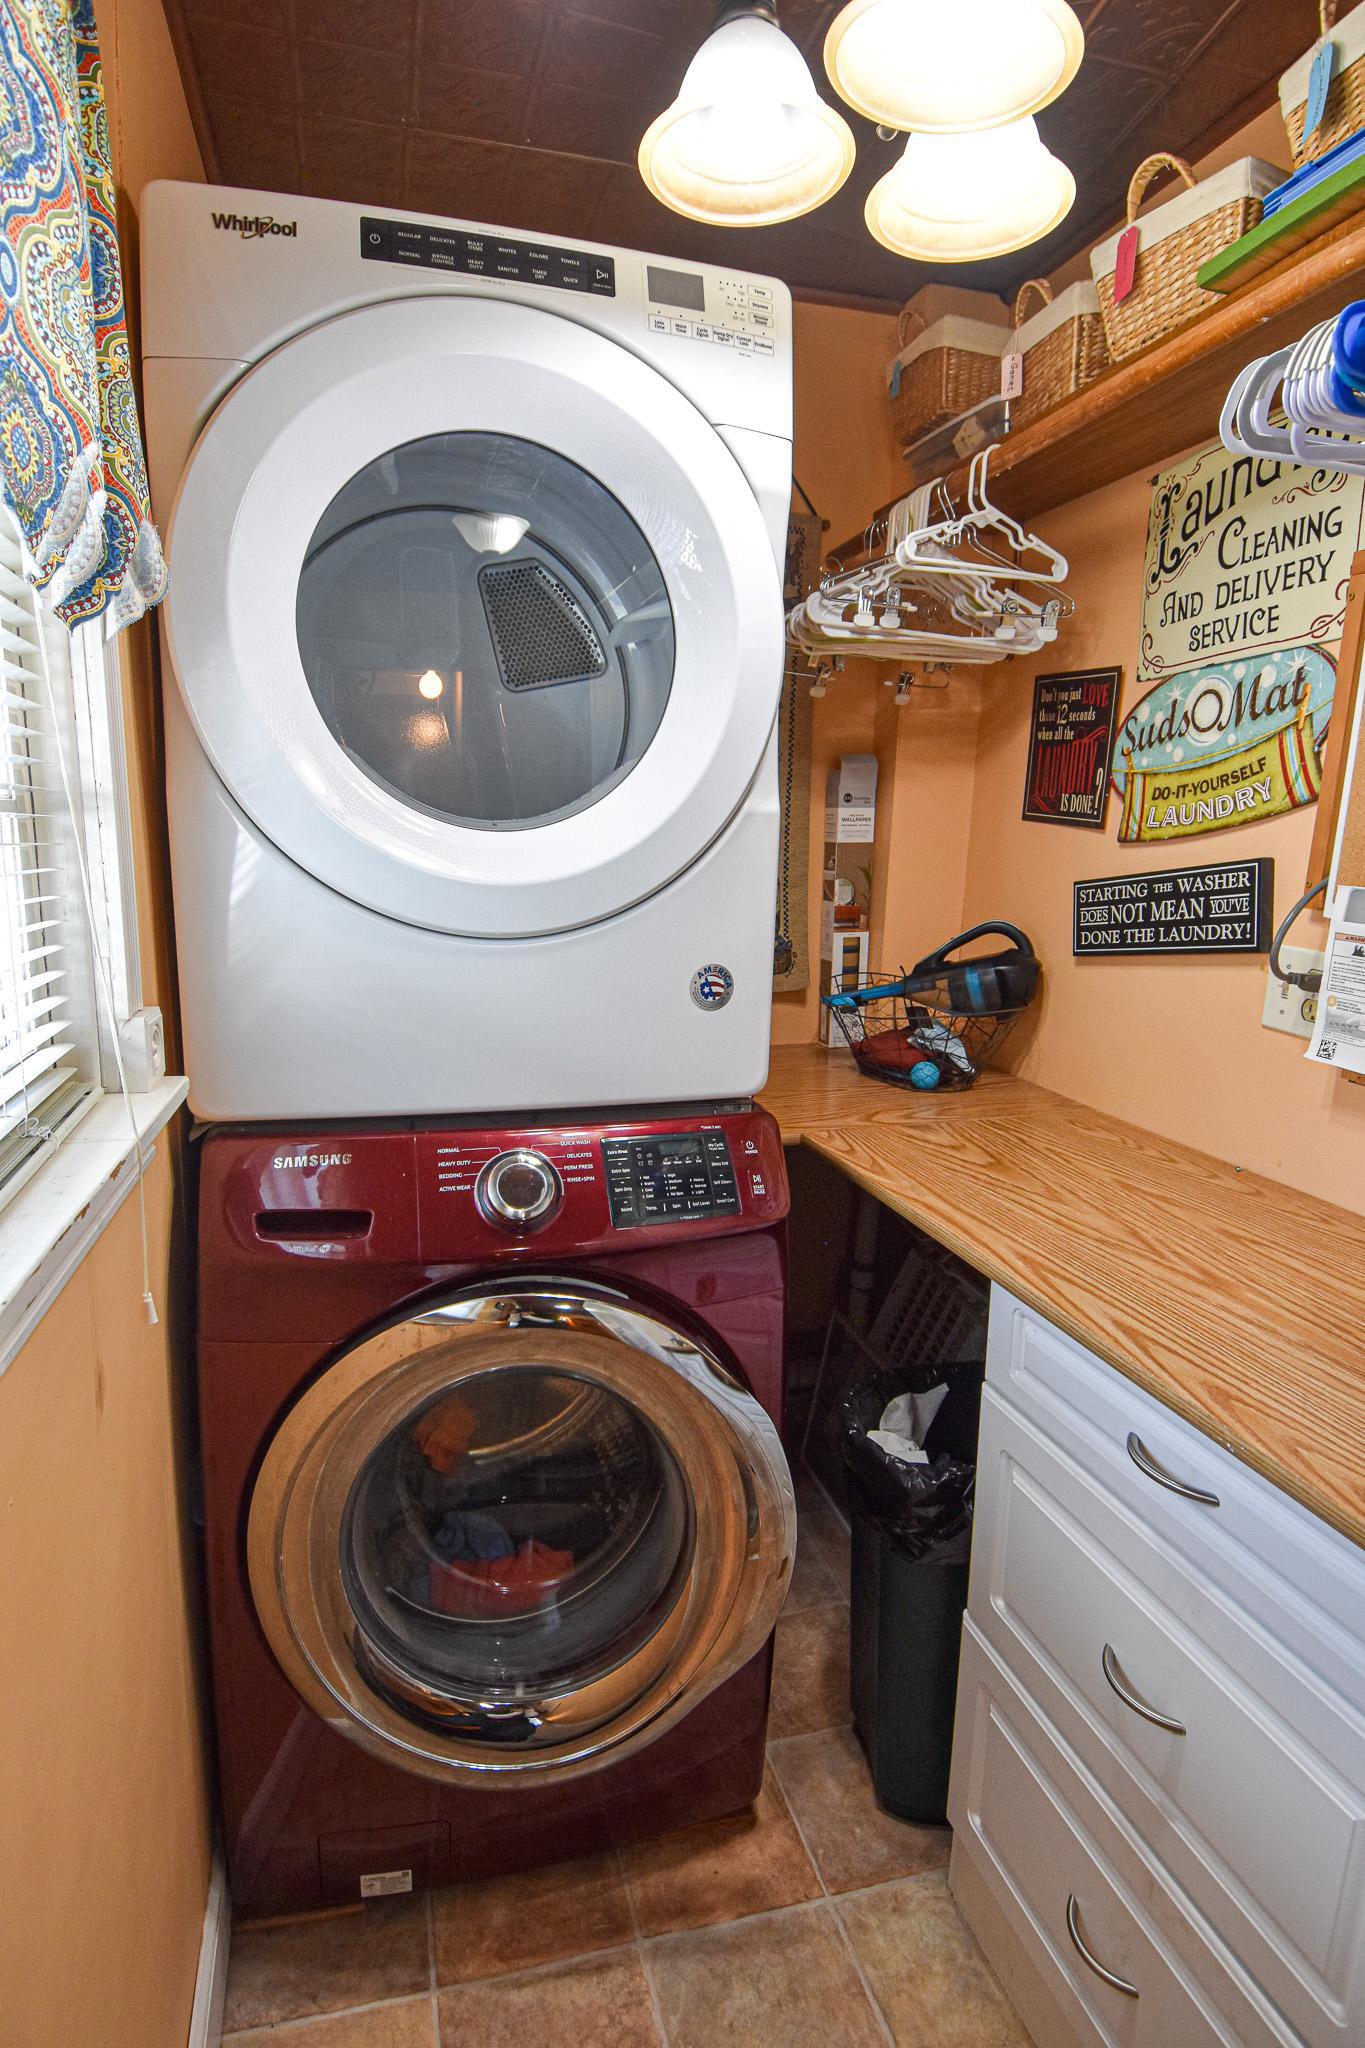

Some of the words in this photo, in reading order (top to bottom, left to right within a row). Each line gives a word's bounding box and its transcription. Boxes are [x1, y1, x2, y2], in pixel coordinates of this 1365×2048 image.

[212, 212, 297, 239] Whirlpool
[398, 231, 421, 239] REGULAR
[430, 236, 455, 245] DELICATES
[498, 247, 517, 255] WHITES
[398, 250, 421, 258] NORMAL
[529, 252, 549, 260] COLORS
[561, 258, 580, 266] TOWELS
[1218, 505, 1343, 569] CLEANING
[1215, 550, 1336, 611] DELIVERY
[1159, 591, 1203, 627] AND
[1189, 605, 1280, 652] SERVICE
[1069, 687, 1082, 703] just
[1082, 682, 1110, 708] LOVE
[1056, 703, 1068, 725] 12
[1068, 706, 1096, 722] seconds
[1037, 726, 1053, 740] when
[1054, 726, 1064, 740] all
[1064, 726, 1075, 740] the
[1033, 733, 1102, 801] LAUNDRY
[1151, 757, 1268, 801] DO-IT-YOURSELF
[1060, 793, 1069, 812] IS
[1146, 776, 1273, 828] LAUNDRY
[1080, 883, 1148, 903] STARTING
[1153, 882, 1174, 893] THE
[1177, 871, 1251, 893] WASHER
[1080, 909, 1109, 923] DOES
[1110, 902, 1147, 924] NOT
[1150, 897, 1205, 921] MEAN
[1209, 897, 1249, 914] YOU'VE
[1081, 930, 1120, 945] DONE
[1124, 928, 1155, 943] THE
[1159, 922, 1251, 942] LAUNDRY!
[697, 966, 733, 989] AMERICA
[273, 1154, 352, 1169] SAMSUNG
